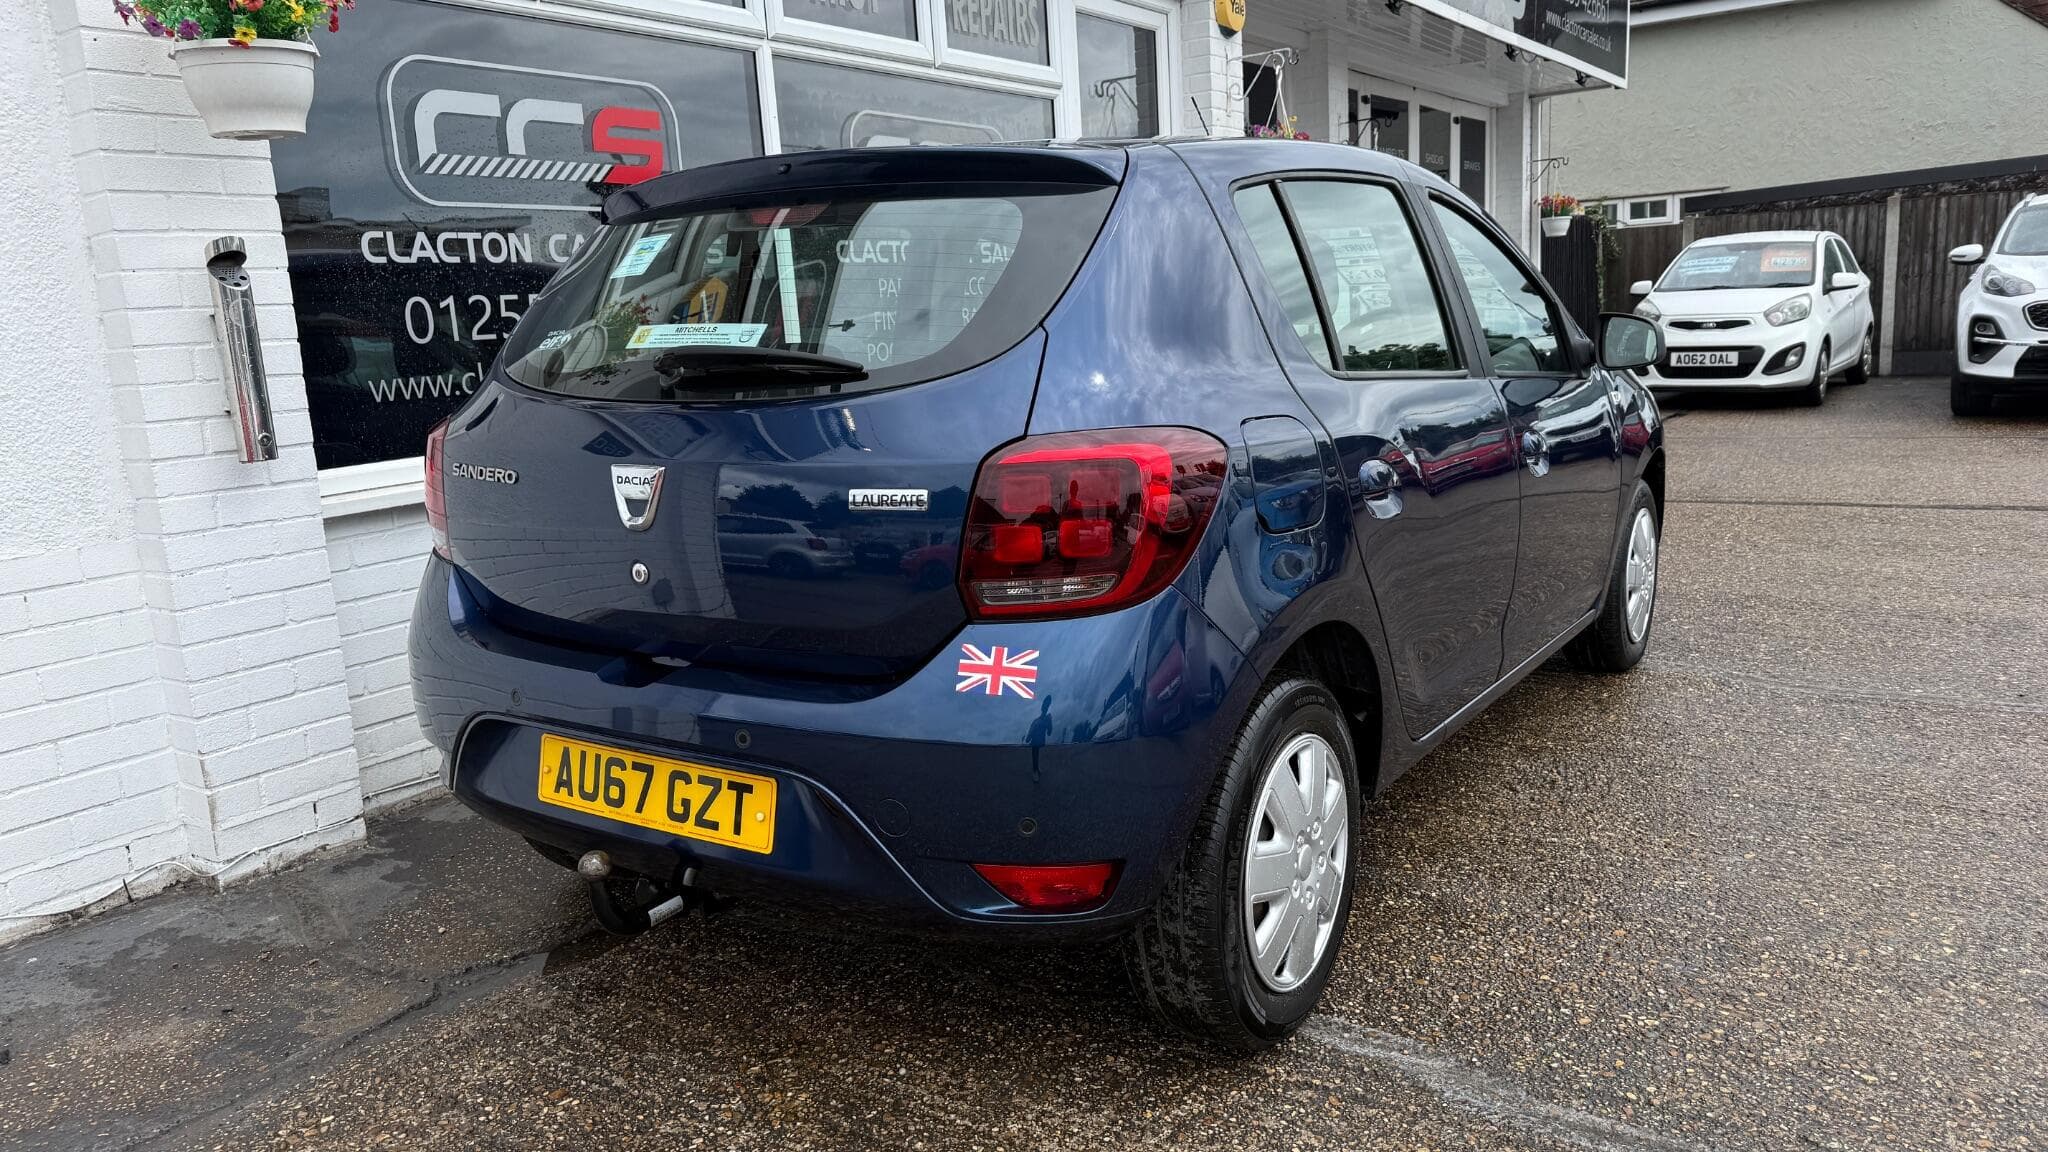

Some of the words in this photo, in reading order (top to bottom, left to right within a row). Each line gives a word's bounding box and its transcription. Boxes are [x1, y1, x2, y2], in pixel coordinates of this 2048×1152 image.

[952, 0, 1040, 46] REPAIRS
[1545, 9, 1612, 52] www.clactoncarsales.co.uk
[360, 230, 534, 264] CLACTON
[404, 294, 540, 345] 0125
[452, 463, 518, 485] SANDERO
[616, 475, 651, 486] DACIA
[852, 494, 925, 507] LAUREATE
[554, 746, 655, 814] AU67
[666, 769, 754, 836] GZT
